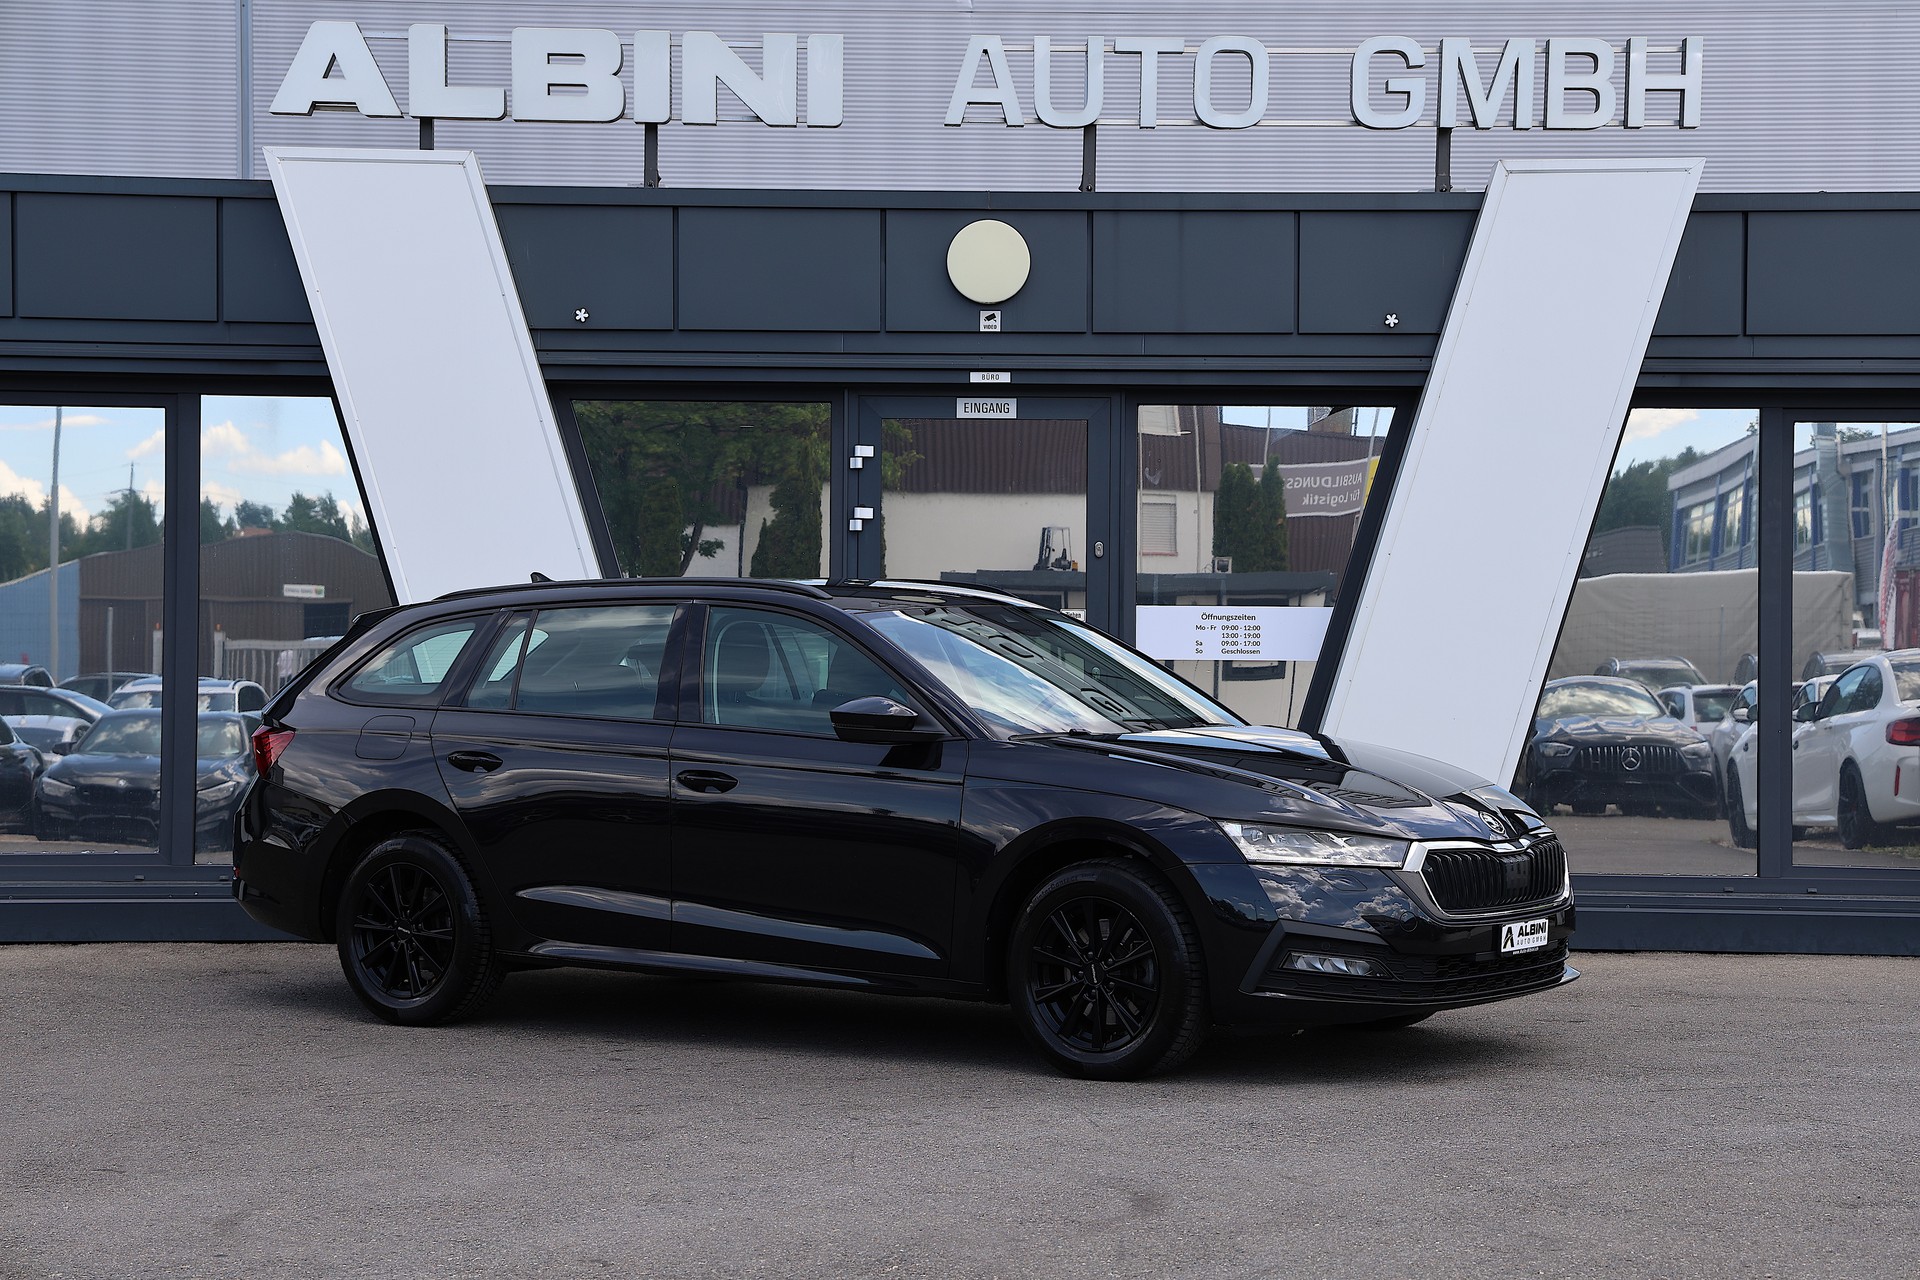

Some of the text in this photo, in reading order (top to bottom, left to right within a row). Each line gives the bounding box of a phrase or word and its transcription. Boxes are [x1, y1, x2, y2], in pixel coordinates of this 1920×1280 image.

[269, 21, 1703, 130] ALBINI AUTO GMBH
[982, 373, 1000, 381] BÜRO
[963, 402, 1010, 414] EINGANG
[1200, 612, 1257, 622] Öffnungszeiten
[1518, 921, 1546, 937] ALBINI
